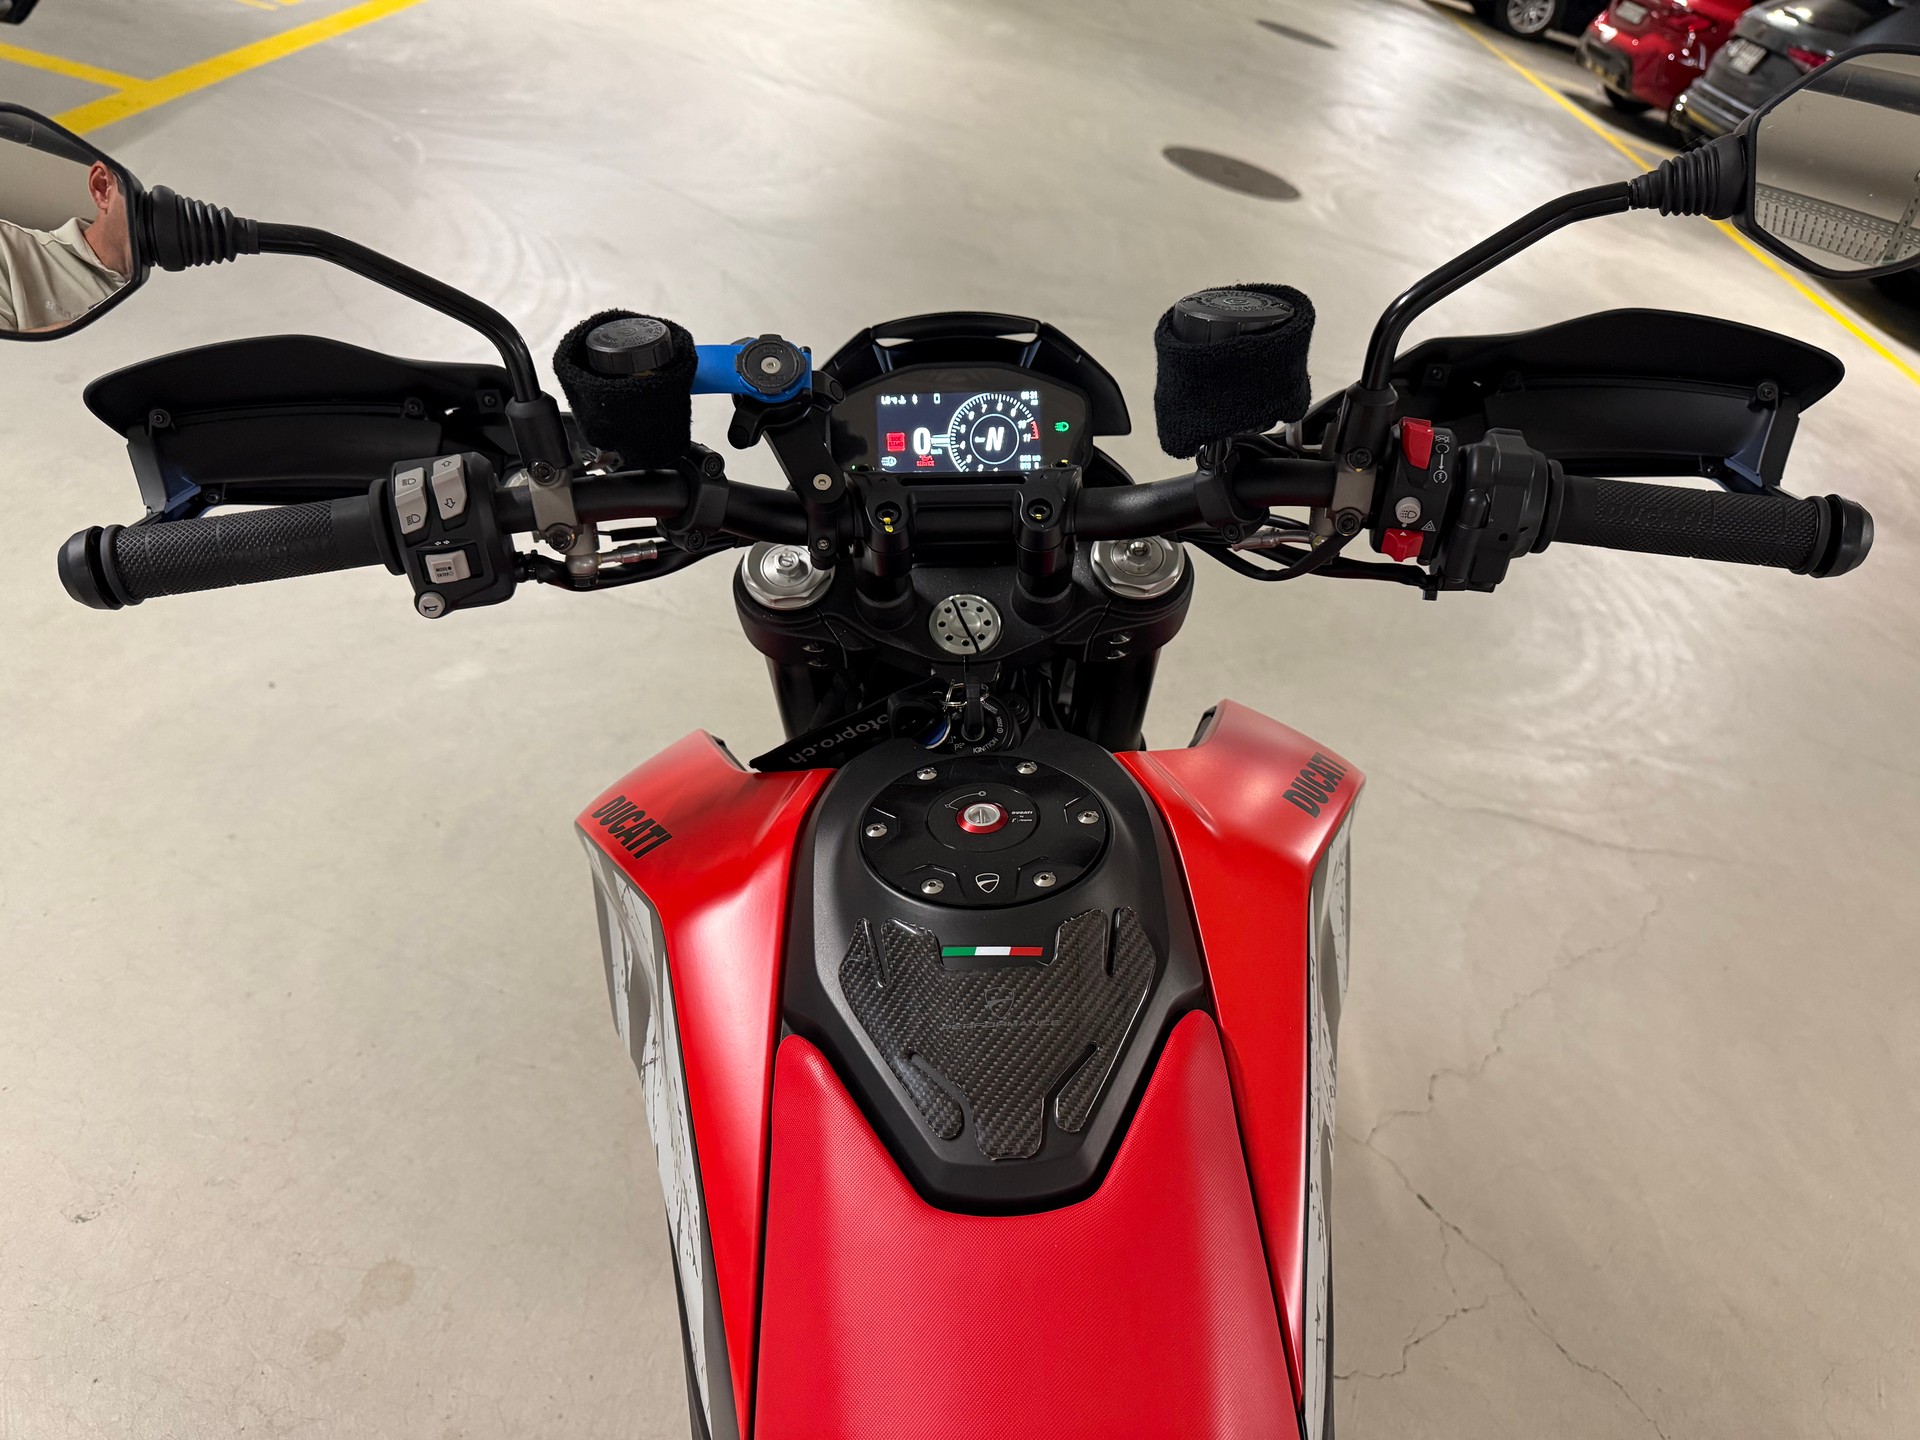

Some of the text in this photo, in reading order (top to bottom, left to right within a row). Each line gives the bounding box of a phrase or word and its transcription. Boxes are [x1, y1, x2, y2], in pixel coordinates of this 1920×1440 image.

[913, 427, 931, 455] 0
[985, 427, 1005, 451] N
[1282, 752, 1348, 819] DUCATI
[591, 795, 673, 860] DUCATI
